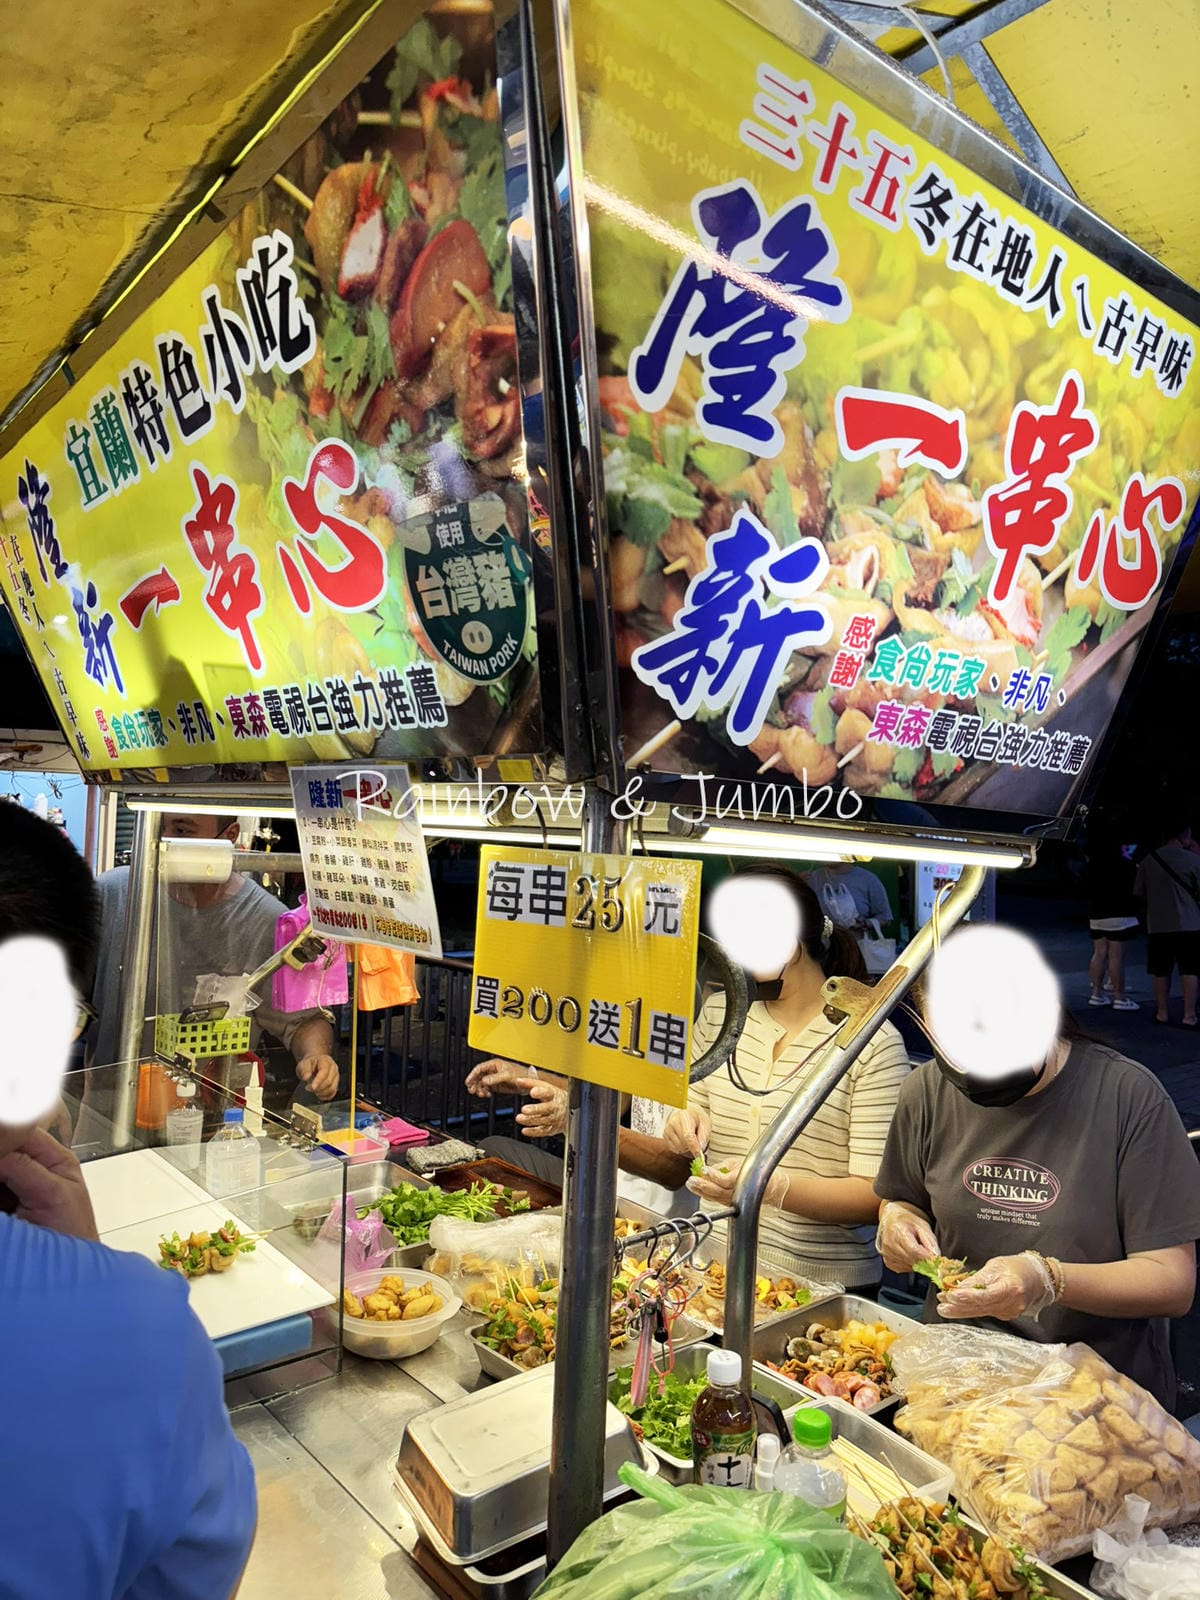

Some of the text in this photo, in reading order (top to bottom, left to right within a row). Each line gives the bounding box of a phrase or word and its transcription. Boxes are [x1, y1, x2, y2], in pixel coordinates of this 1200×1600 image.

[67, 239, 312, 505] 宜蘭特色小吃
[841, 378, 1184, 604] 一串心
[120, 443, 385, 671] 一串心
[435, 520, 465, 548] 使用
[415, 550, 517, 619] 台灣豬
[443, 632, 519, 676] TAIWAN PORK
[829, 615, 876, 687] 感謝
[868, 702, 1092, 773] 東森電視台強力推薦
[473, 976, 687, 1066] 買200送1串
[971, 1181, 1049, 1203] THINKING
[973, 1164, 1049, 1185] CREATIVE
[976, 1213, 992, 1221] truly
[1010, 1216, 1041, 1226] difference
[980, 1208, 1038, 1220] unique mindset that
